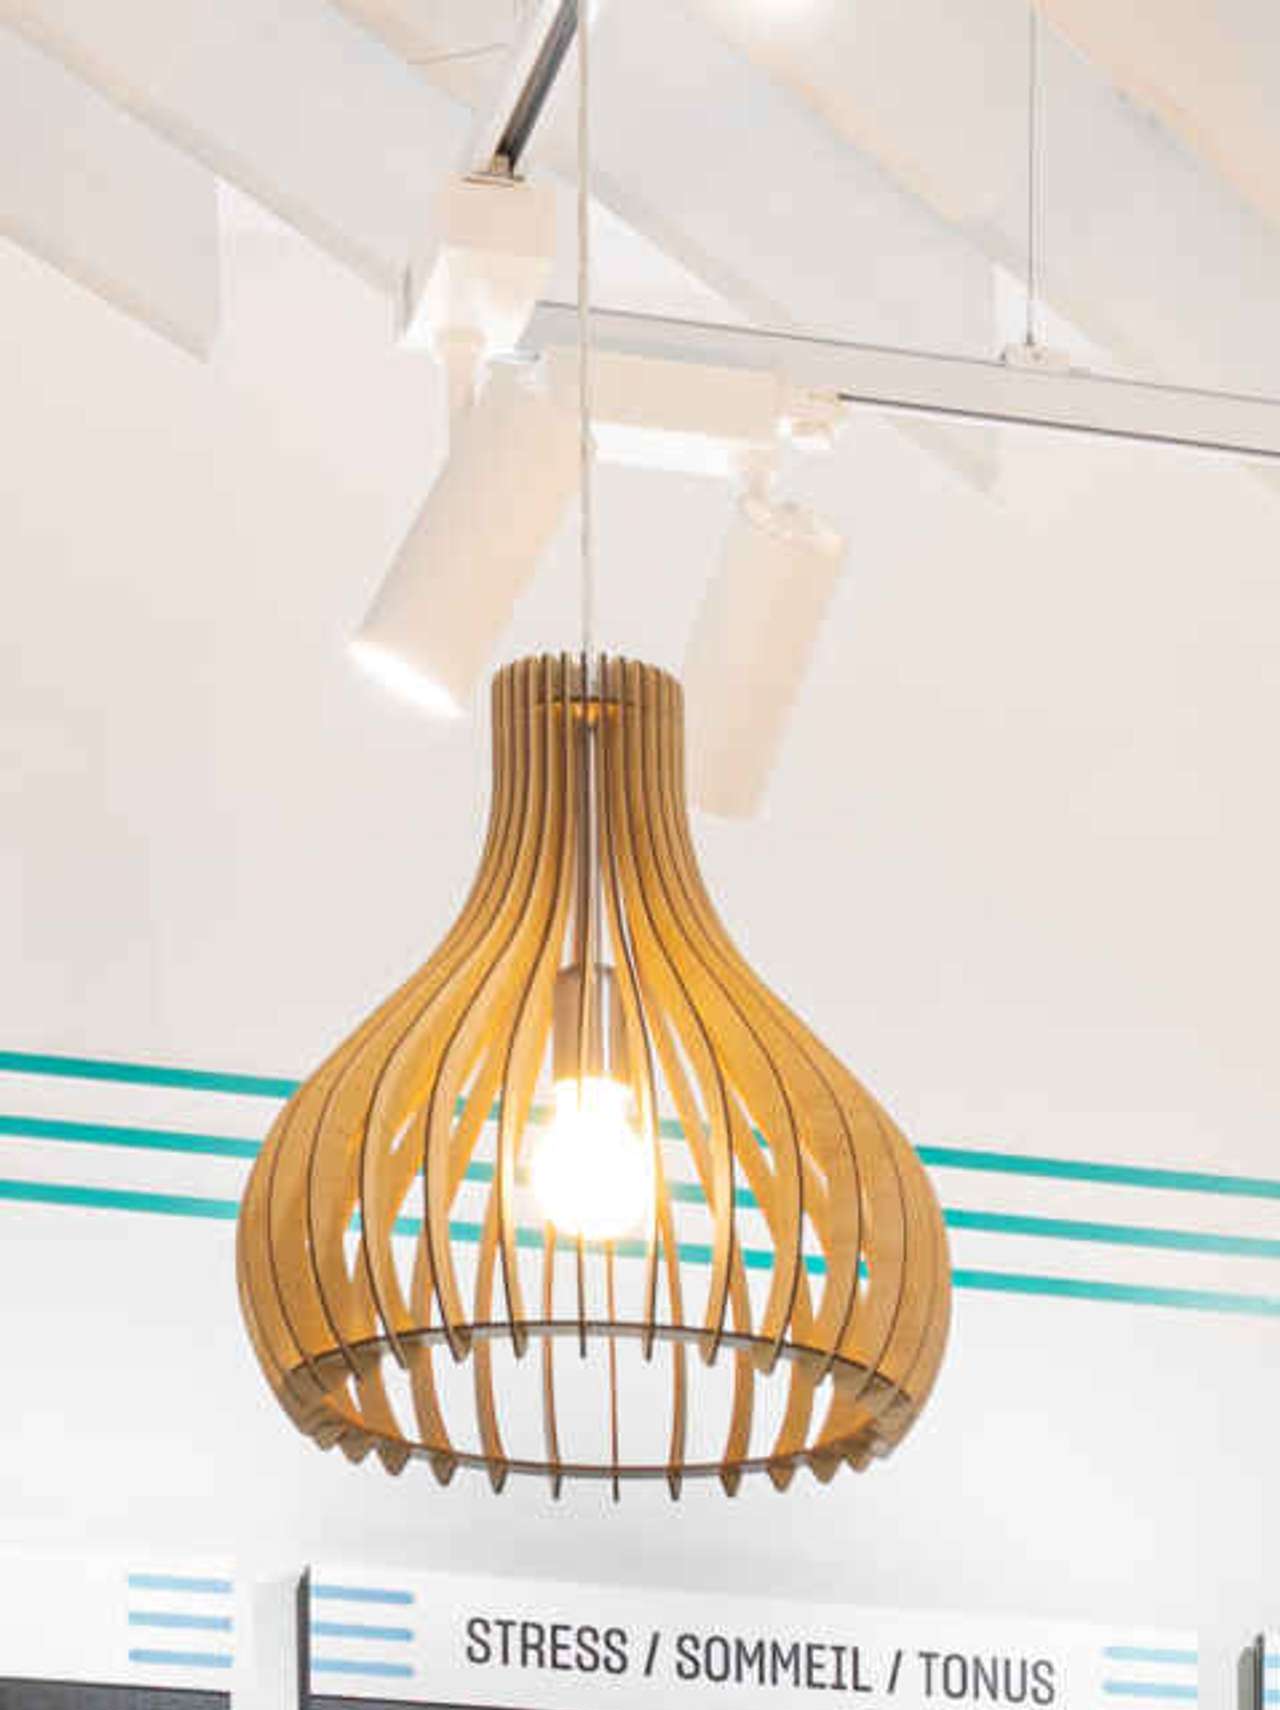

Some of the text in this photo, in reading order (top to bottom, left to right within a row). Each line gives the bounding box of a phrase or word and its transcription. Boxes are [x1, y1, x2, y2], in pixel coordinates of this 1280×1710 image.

[466, 1617, 629, 1674] STRESS
[675, 1633, 871, 1694] SOMMEIL
[918, 1651, 1056, 1706] TONUS
